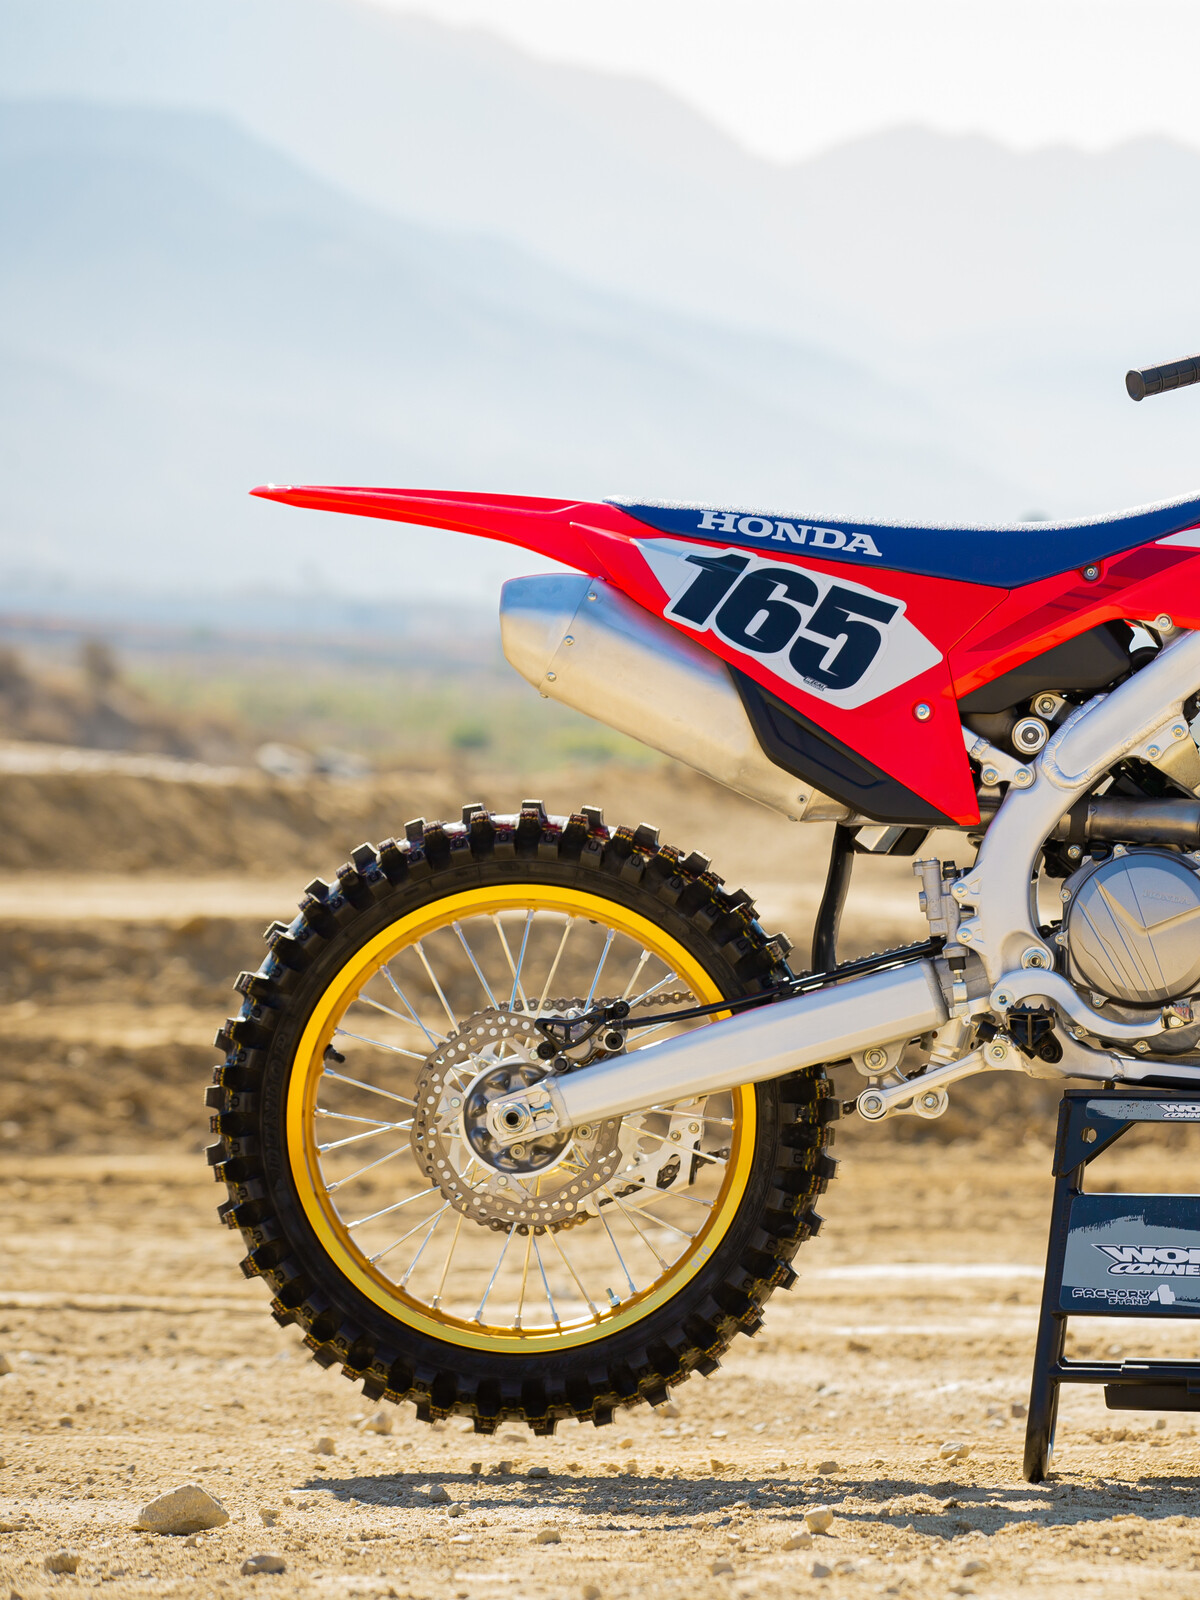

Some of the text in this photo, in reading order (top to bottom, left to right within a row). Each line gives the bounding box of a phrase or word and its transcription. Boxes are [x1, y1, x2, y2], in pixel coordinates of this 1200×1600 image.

[697, 510, 882, 557] HONDA
[671, 553, 900, 690] 165
[1072, 1288, 1151, 1299] FACTORY
[1109, 1297, 1150, 1305] STAND
